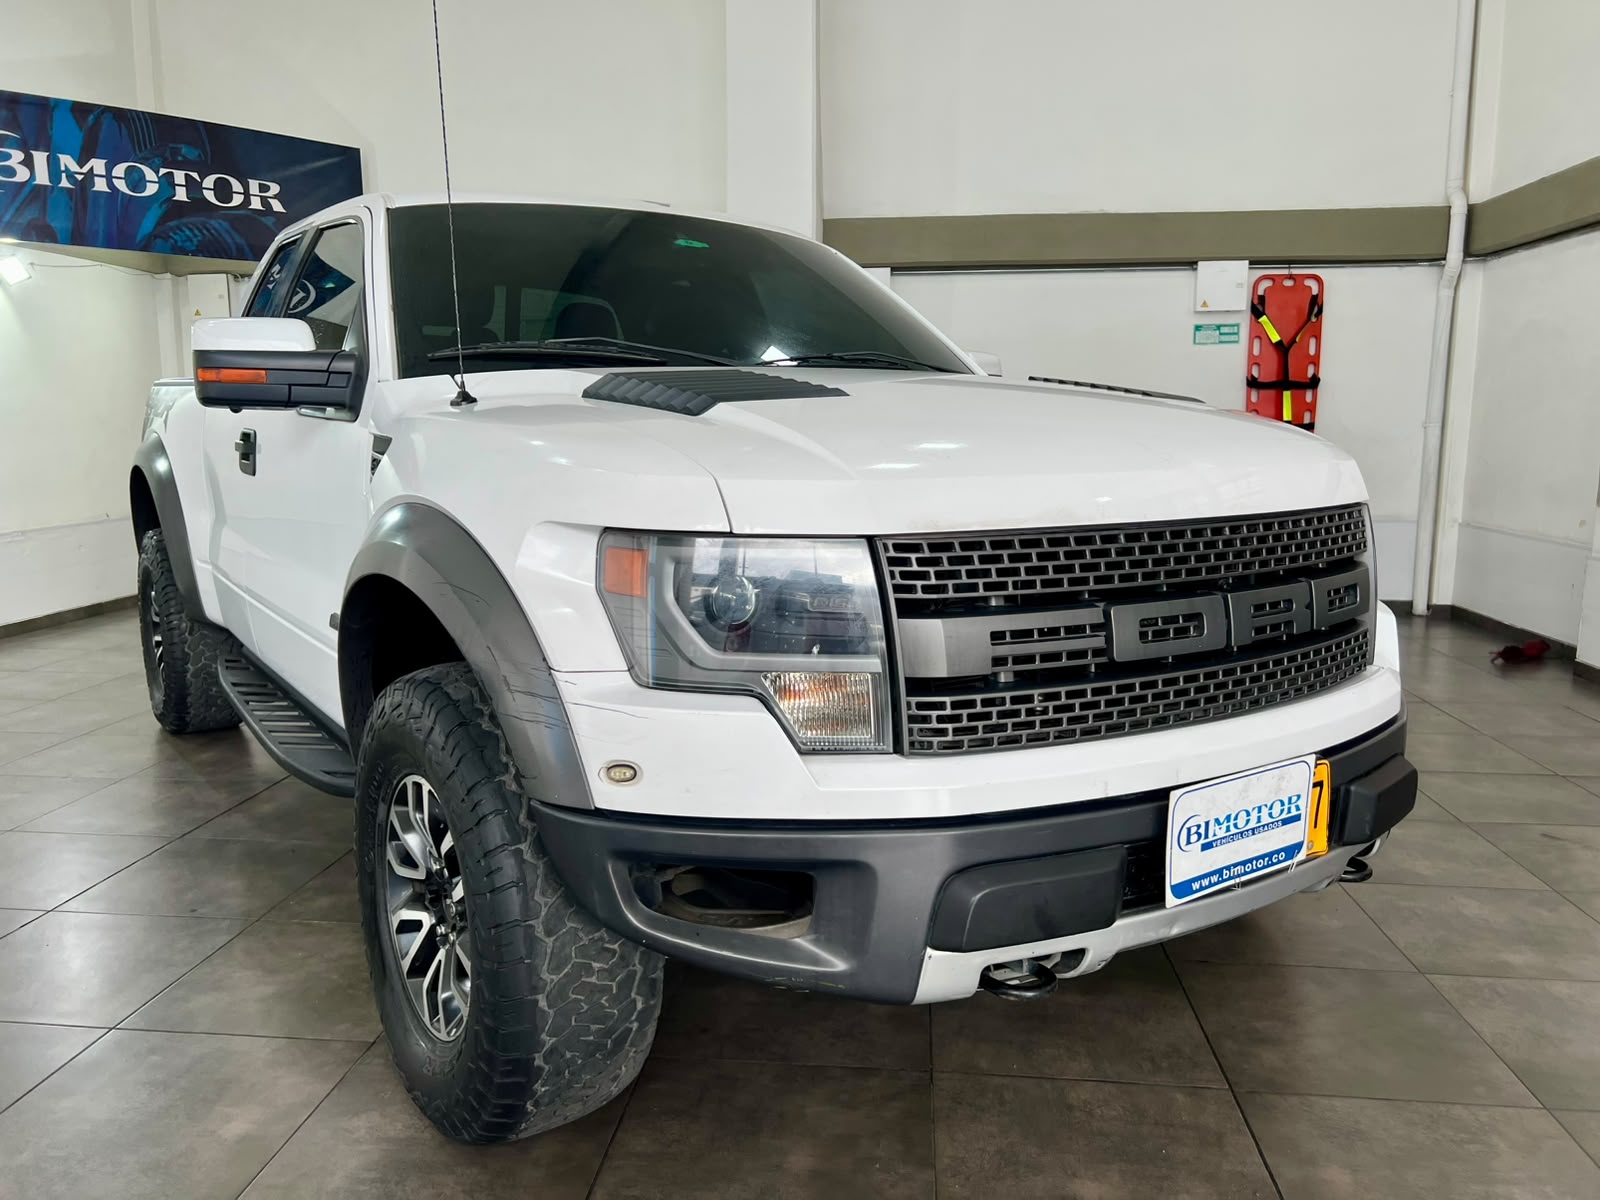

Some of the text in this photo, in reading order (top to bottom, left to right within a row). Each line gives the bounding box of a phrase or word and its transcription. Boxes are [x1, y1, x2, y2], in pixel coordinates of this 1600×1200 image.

[0, 147, 287, 213] BIMOTOR
[899, 562, 1370, 678] FORD
[1184, 794, 1302, 847] BIMOTOR
[1254, 820, 1283, 834] USADOS
[1191, 851, 1286, 891] www.bimotor.co
